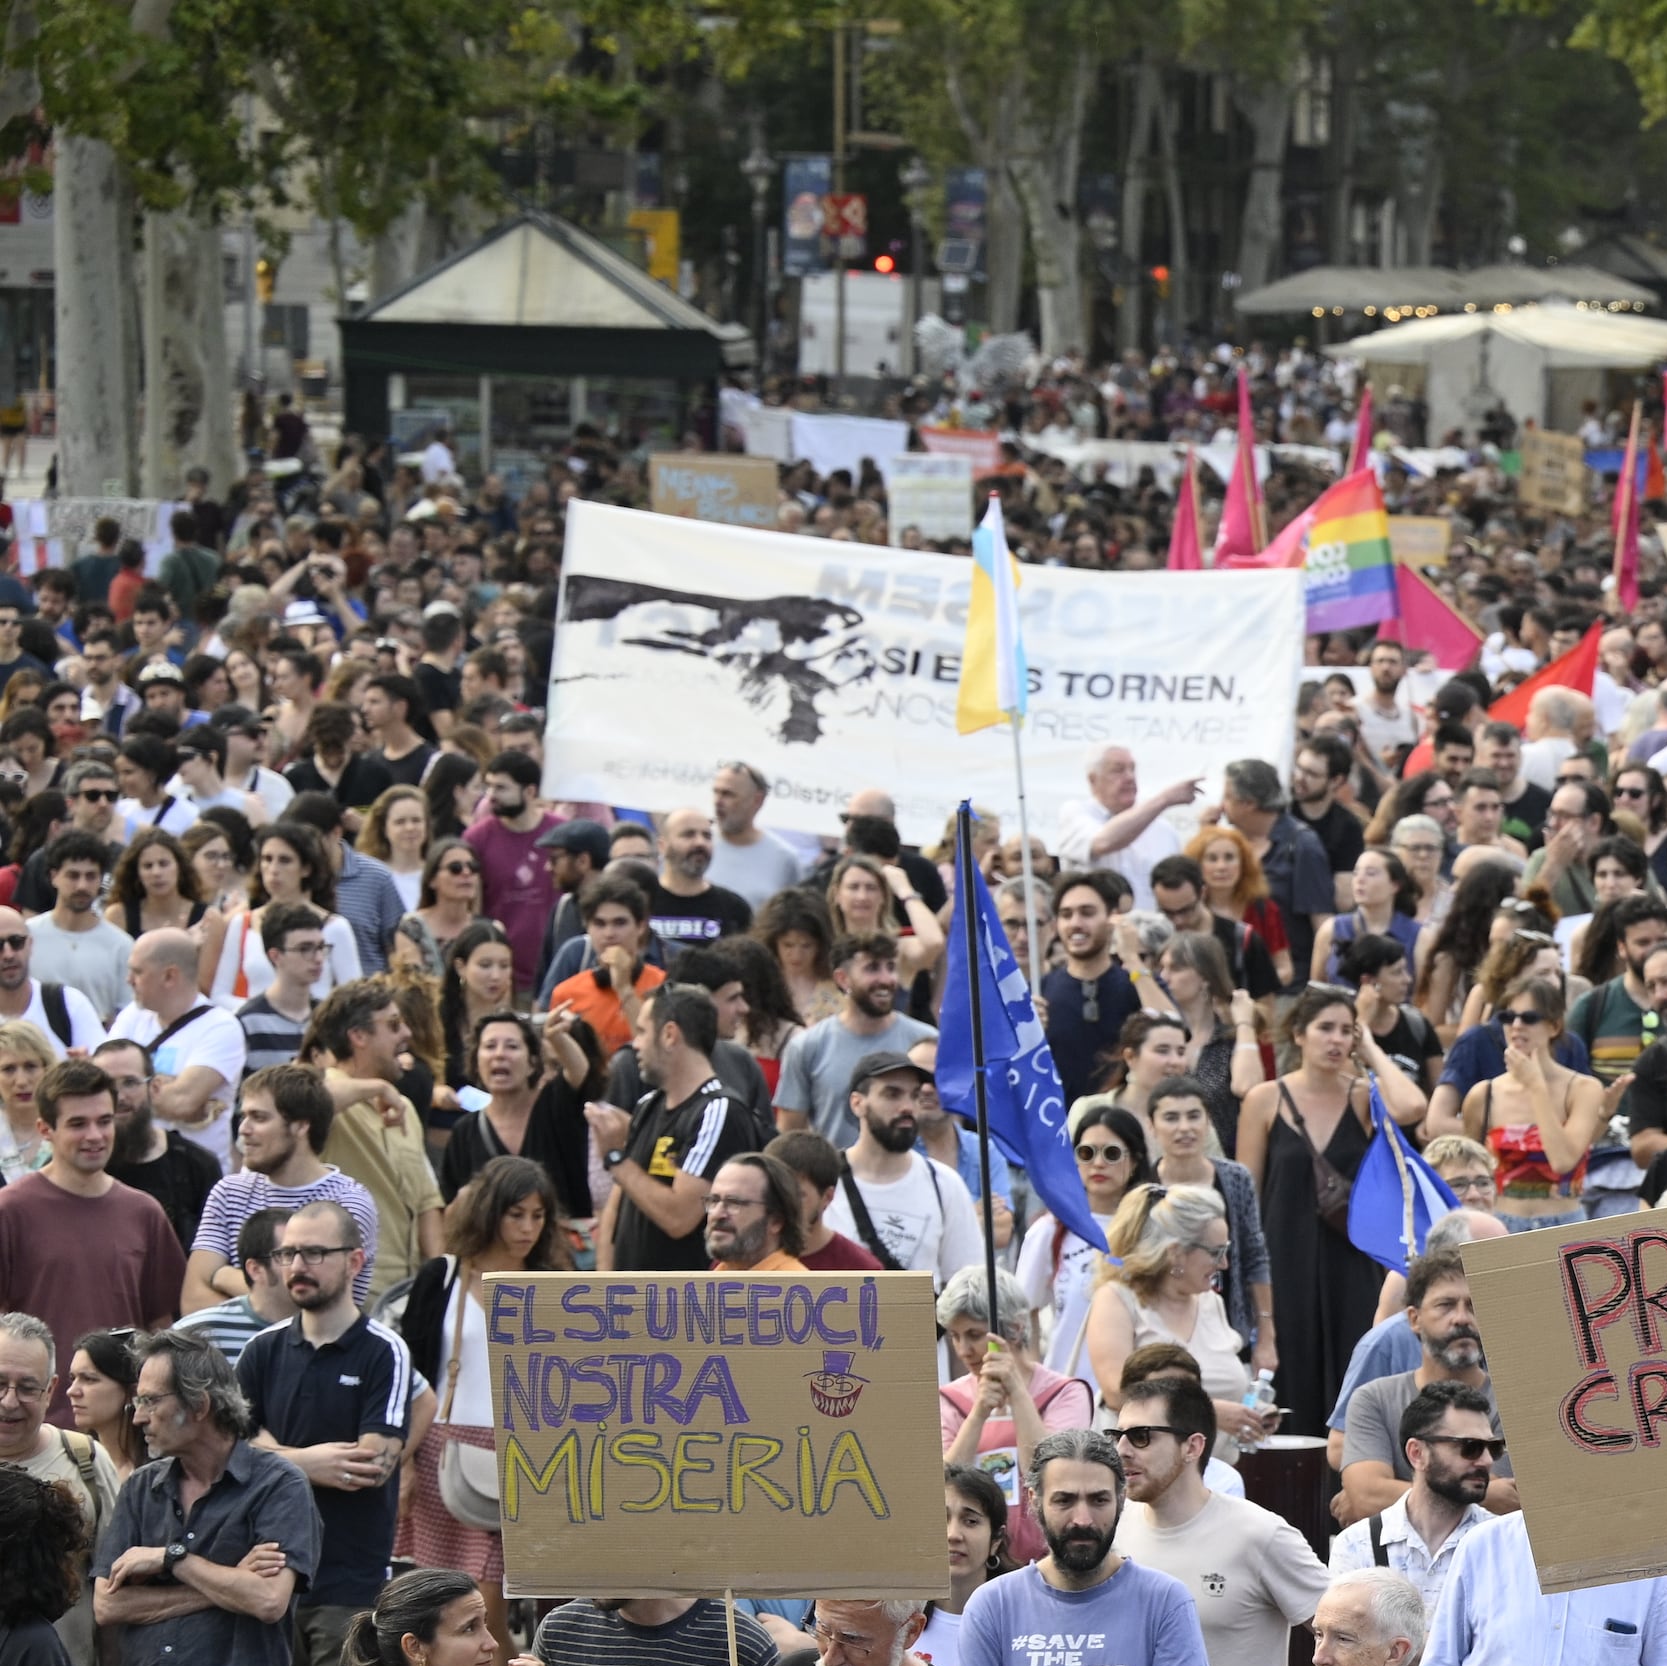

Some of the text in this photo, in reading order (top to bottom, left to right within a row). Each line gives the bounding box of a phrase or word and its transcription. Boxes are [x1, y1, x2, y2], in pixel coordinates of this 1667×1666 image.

[883, 648, 920, 676] SI
[1054, 670, 1246, 704] TORNEN,
[1123, 707, 1254, 745] TAMBÉ
[492, 1285, 558, 1343] EL
[564, 1282, 679, 1342] SEU
[503, 1352, 750, 1432] NOSTRA
[1011, 1633, 1106, 1652] #SAVE
[1026, 1651, 1083, 1666] THE
